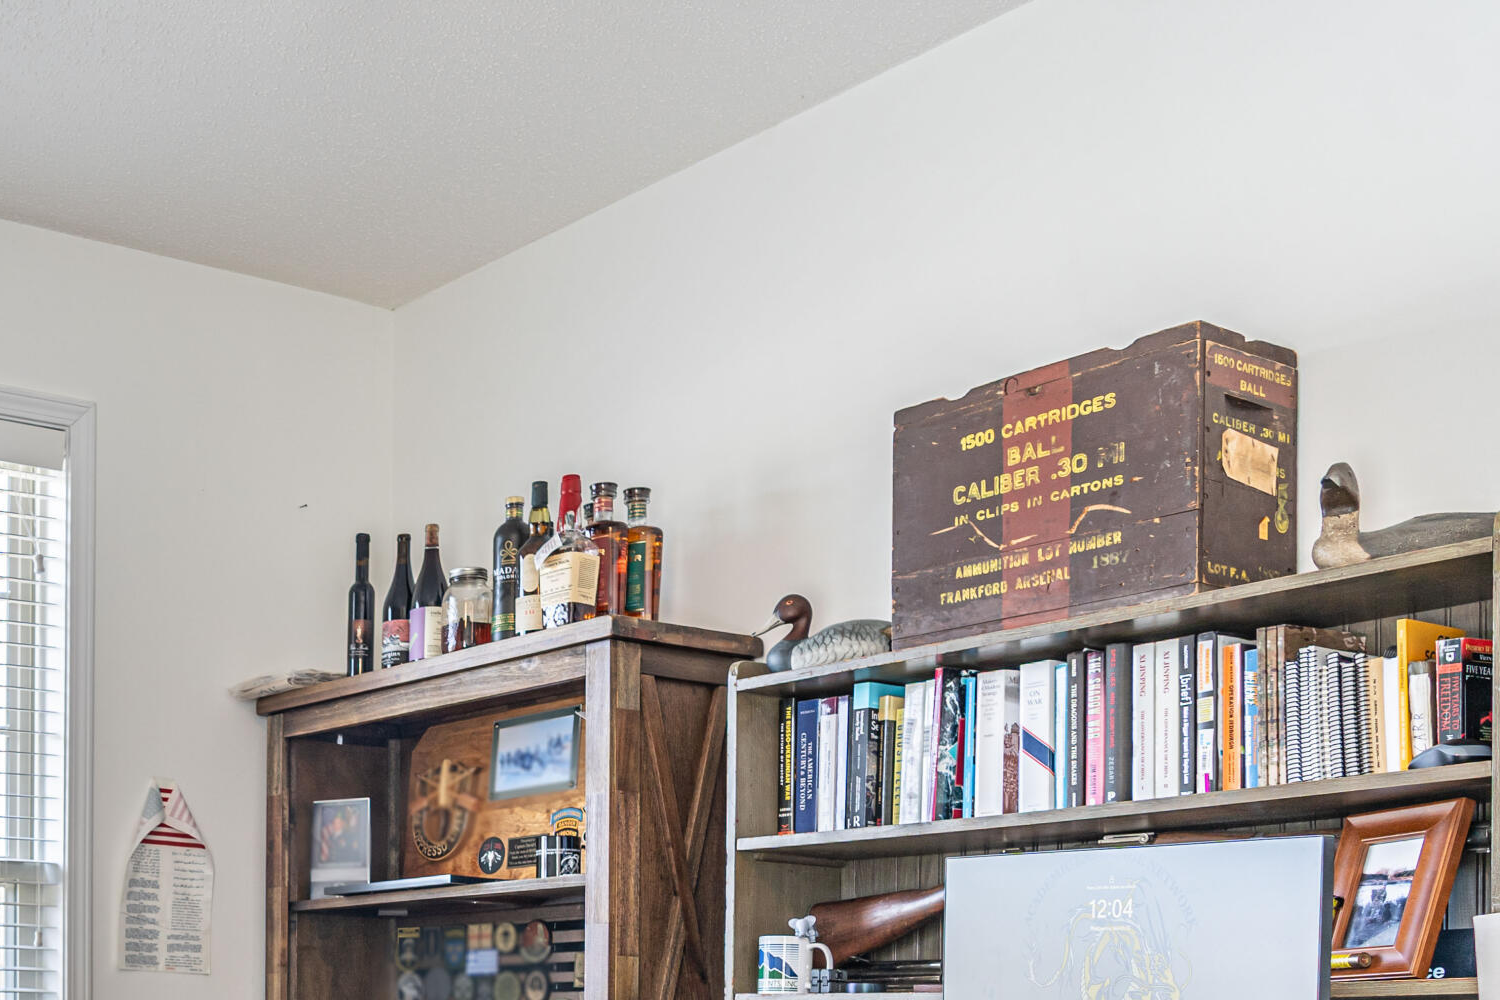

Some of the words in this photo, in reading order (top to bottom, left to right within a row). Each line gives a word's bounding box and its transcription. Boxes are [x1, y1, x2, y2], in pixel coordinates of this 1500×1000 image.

[1240, 380, 1266, 398] BALL
[960, 428, 995, 451] 1500
[1002, 392, 1116, 438] CARTRIDGES
[1212, 412, 1256, 434] CALIBER
[1007, 436, 1065, 466] BALL
[953, 466, 1040, 505] CALIBER
[1050, 453, 1087, 480] .30
[976, 501, 1019, 521] CLIPS
[1027, 496, 1042, 509] IN
[1050, 474, 1124, 502] CARTONS
[955, 550, 1029, 580] AMMUNITION
[1038, 544, 1060, 562] LOT
[1208, 561, 1227, 576] LOT
[940, 581, 1008, 605] FRANKFORD
[1015, 566, 1071, 590] ARSENAL
[1088, 656, 1101, 673] THE
[1139, 654, 1146, 663] XI
[1163, 651, 1170, 660] XI
[1479, 666, 1491, 676] YEA
[1088, 677, 1101, 715] SHADOW
[1180, 674, 1192, 706] [brief]
[1245, 671, 1258, 706] INFLUENCE
[1027, 697, 1043, 705] WAR
[1440, 677, 1451, 731] FREEDOM
[1088, 719, 1100, 739] WAR
[1452, 719, 1459, 730] TO
[1089, 899, 1133, 919] 12:04
